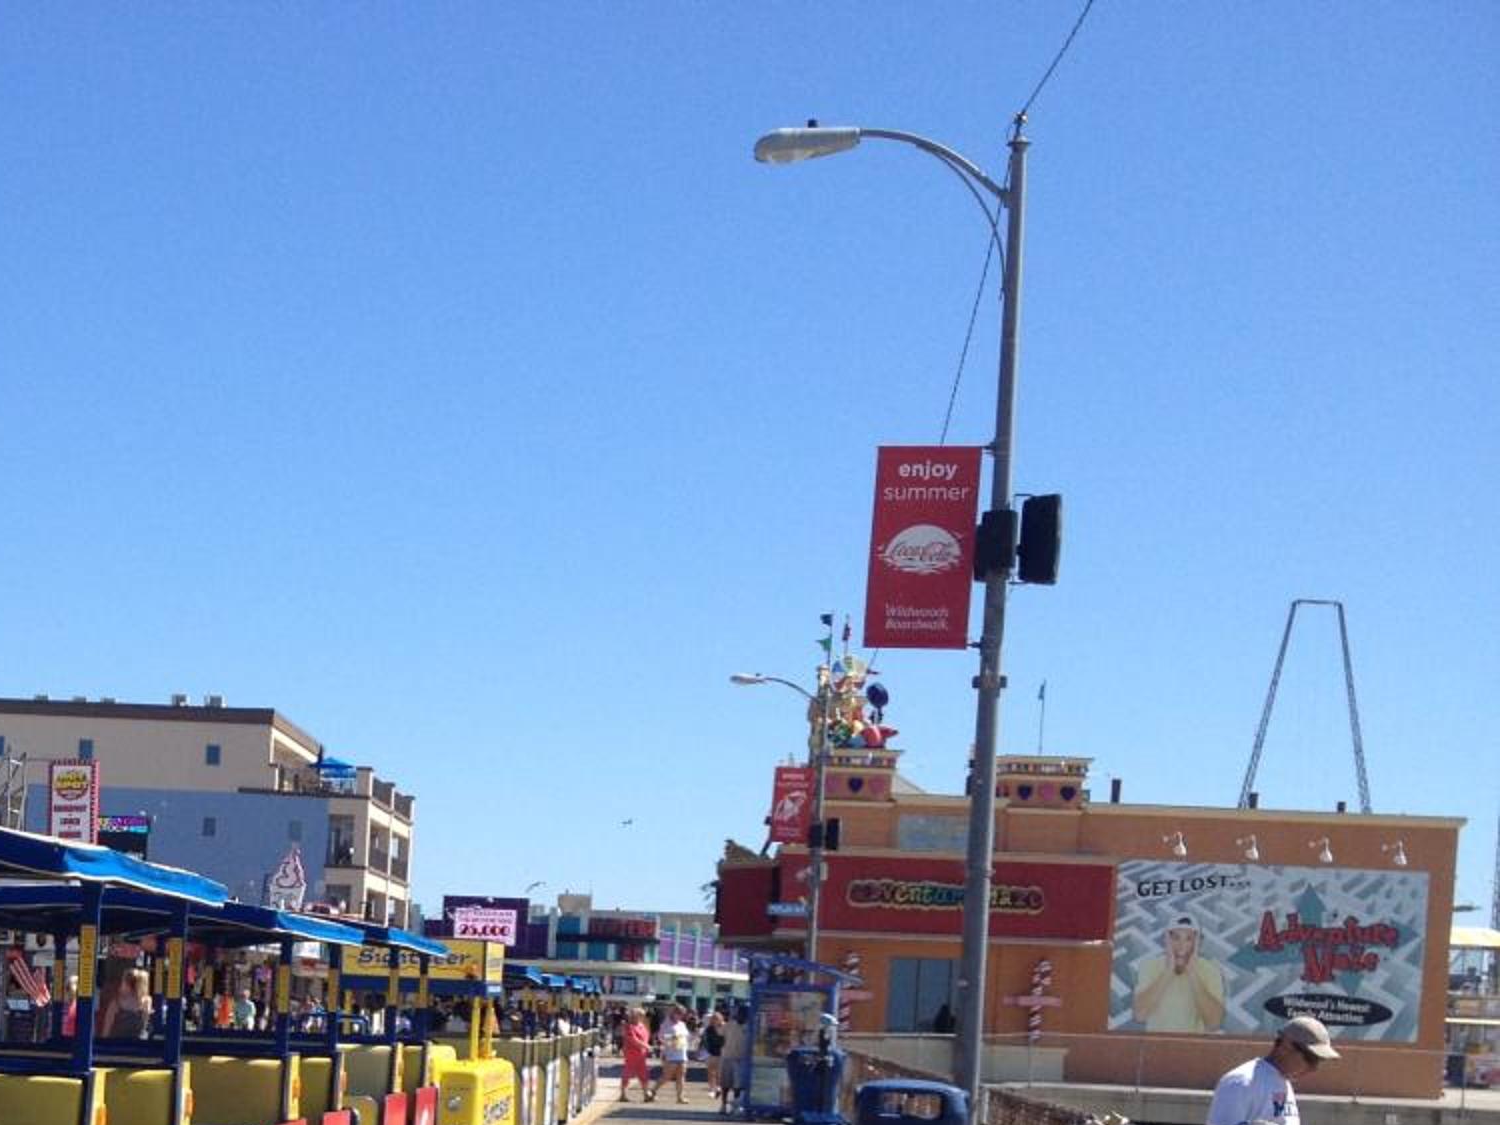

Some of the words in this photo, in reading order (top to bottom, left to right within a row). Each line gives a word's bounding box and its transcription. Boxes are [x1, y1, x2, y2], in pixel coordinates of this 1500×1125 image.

[899, 459, 959, 481] enjoy
[884, 484, 969, 501] summer
[1137, 880, 1175, 897] GET
